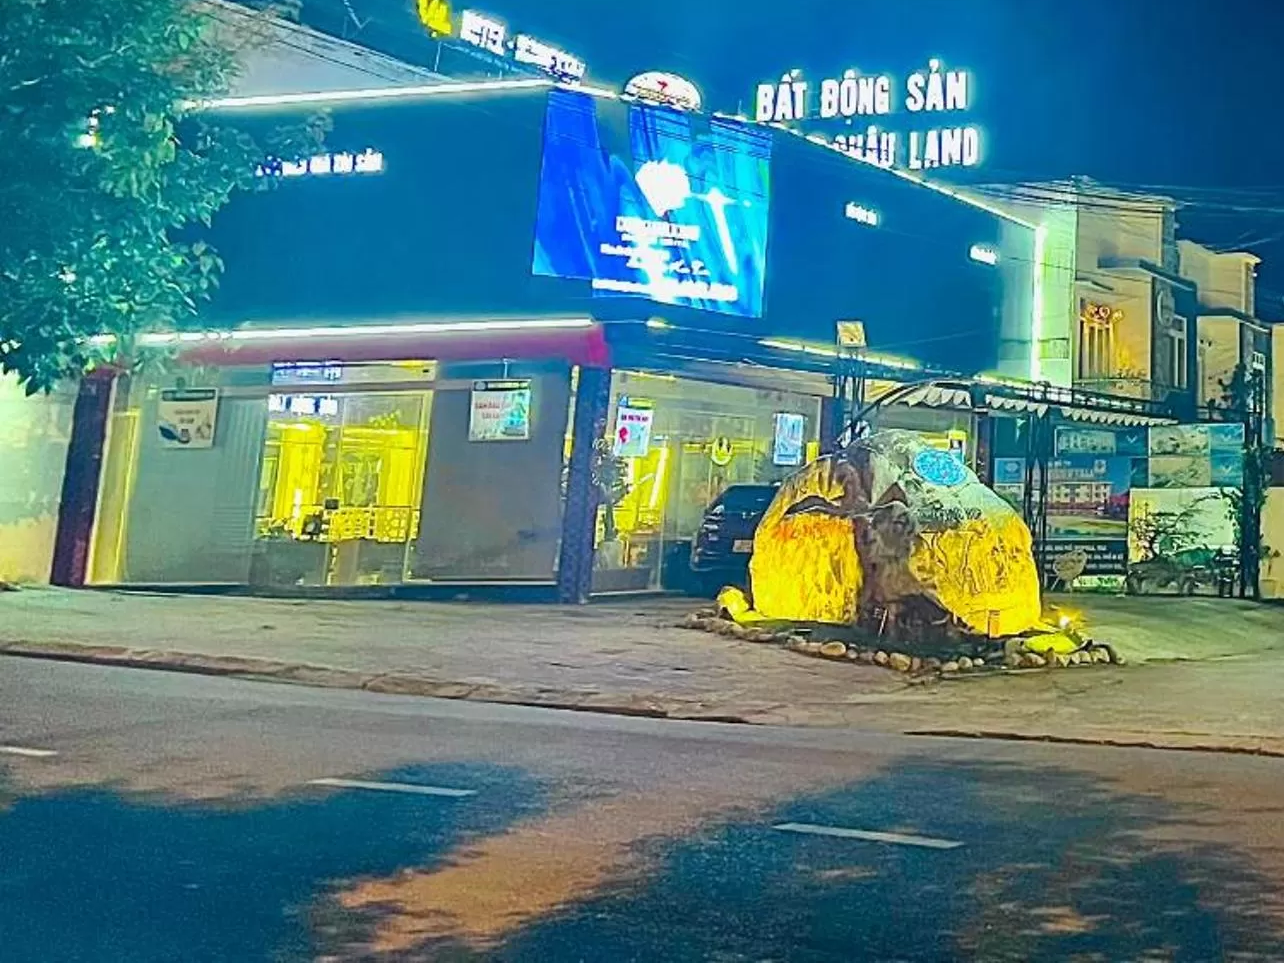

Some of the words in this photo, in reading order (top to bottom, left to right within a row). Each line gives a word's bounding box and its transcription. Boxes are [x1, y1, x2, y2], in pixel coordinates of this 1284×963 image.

[756, 69, 807, 122] BẤT
[905, 58, 967, 112] SẢN
[909, 127, 979, 170] LAND
